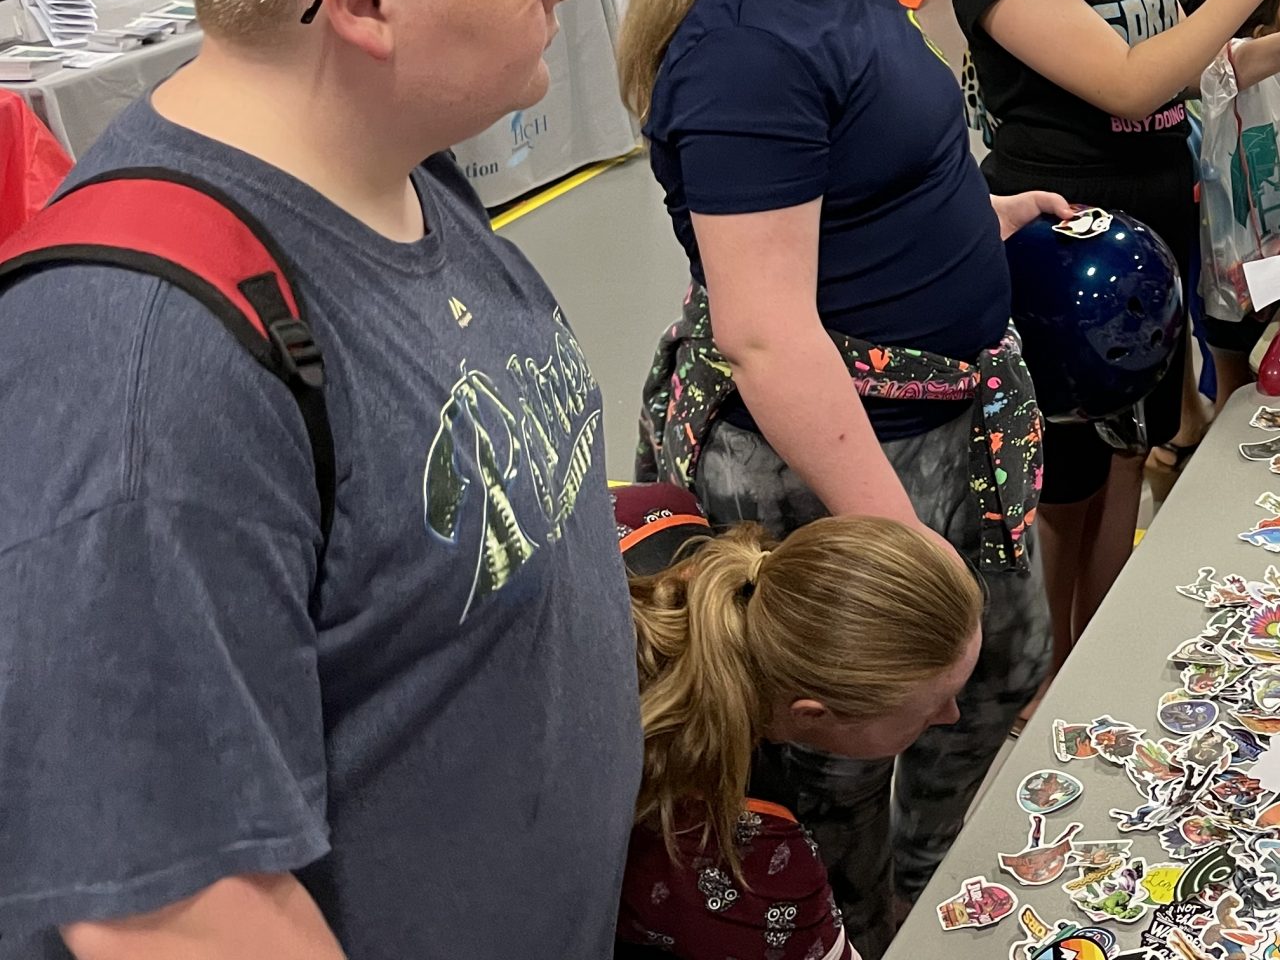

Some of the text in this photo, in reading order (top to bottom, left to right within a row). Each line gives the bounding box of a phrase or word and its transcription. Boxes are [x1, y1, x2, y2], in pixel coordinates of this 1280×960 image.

[1111, 103, 1185, 133] BUSY DOING
[1176, 903, 1202, 914] NOT
